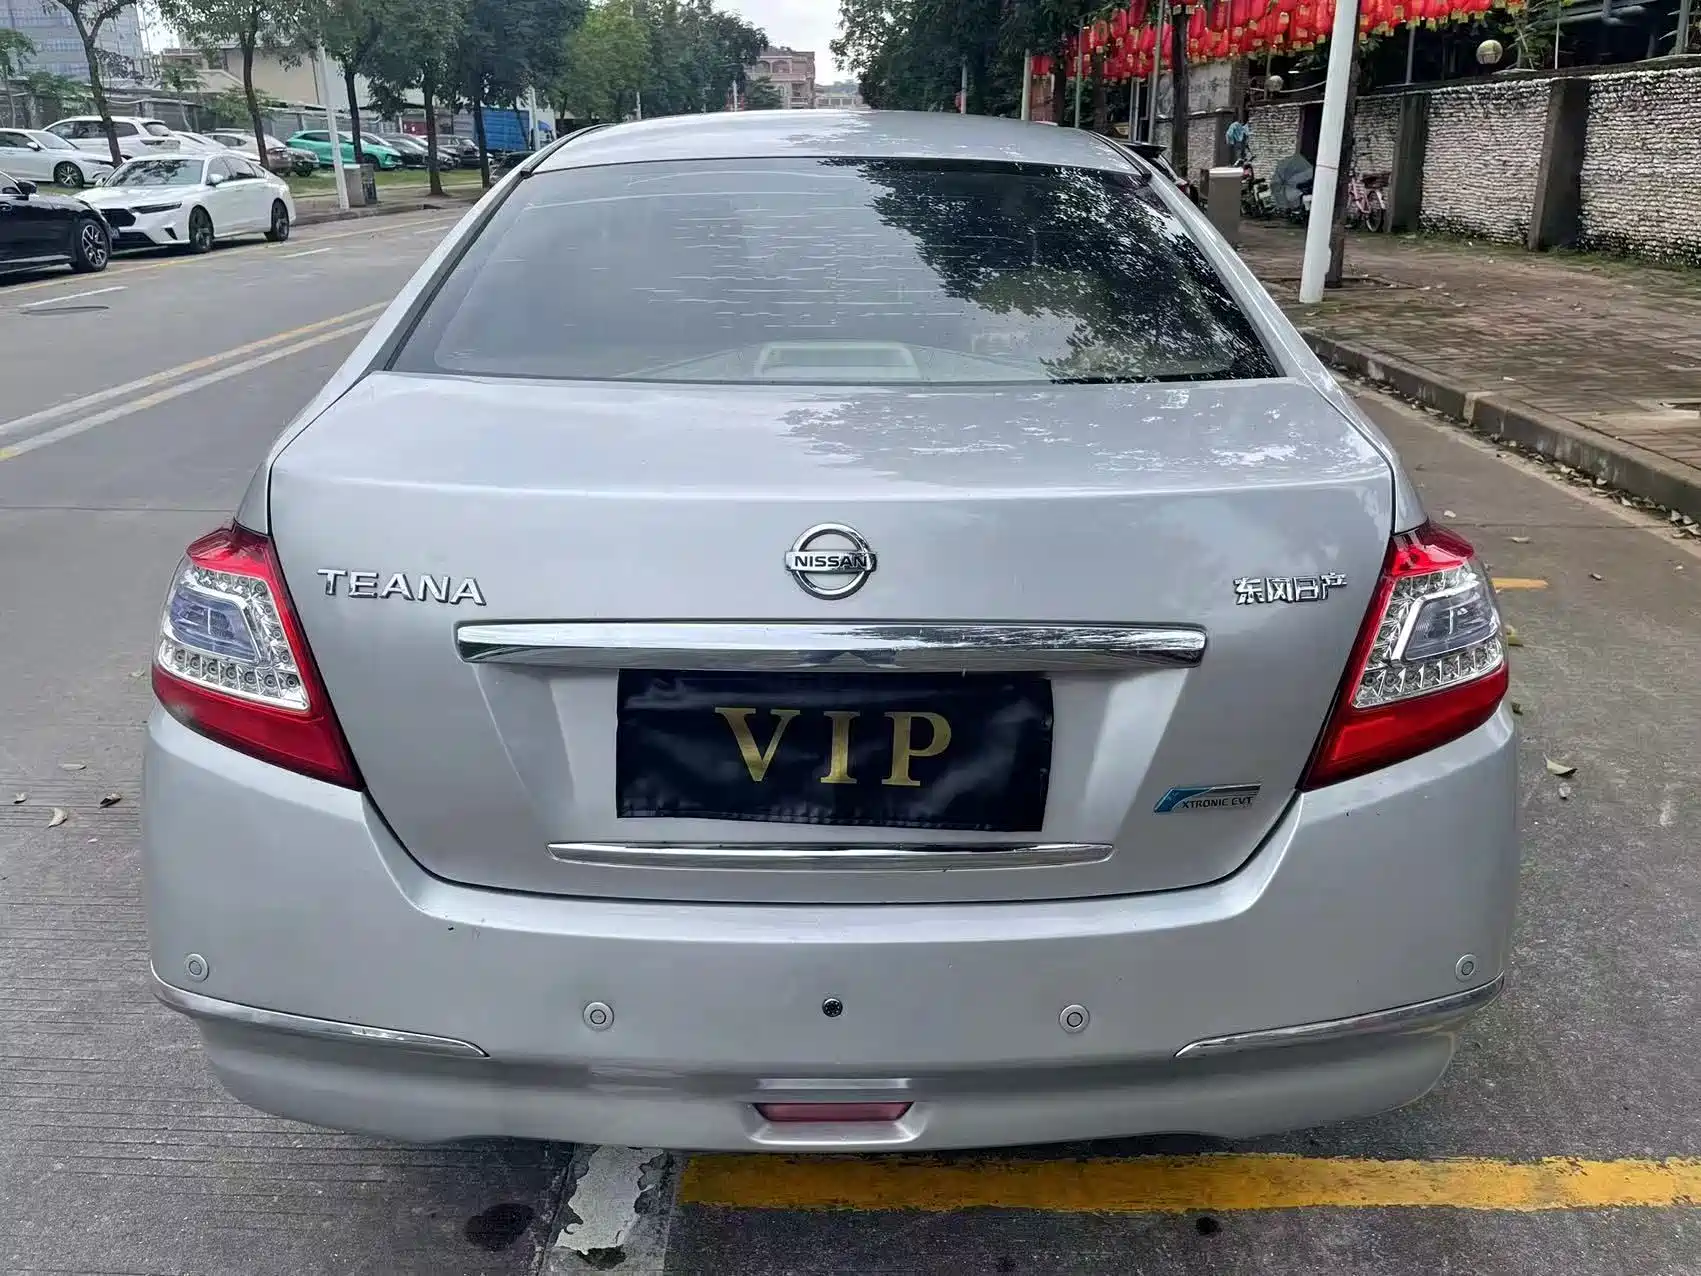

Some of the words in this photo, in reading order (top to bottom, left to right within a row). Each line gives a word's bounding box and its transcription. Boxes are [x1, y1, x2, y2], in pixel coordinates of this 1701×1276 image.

[794, 555, 867, 568] NISSAN
[316, 568, 487, 606] TEANA
[1233, 572, 1347, 605] 东风日产
[715, 706, 952, 787] VIP
[1182, 798, 1228, 809] XTRONIC
